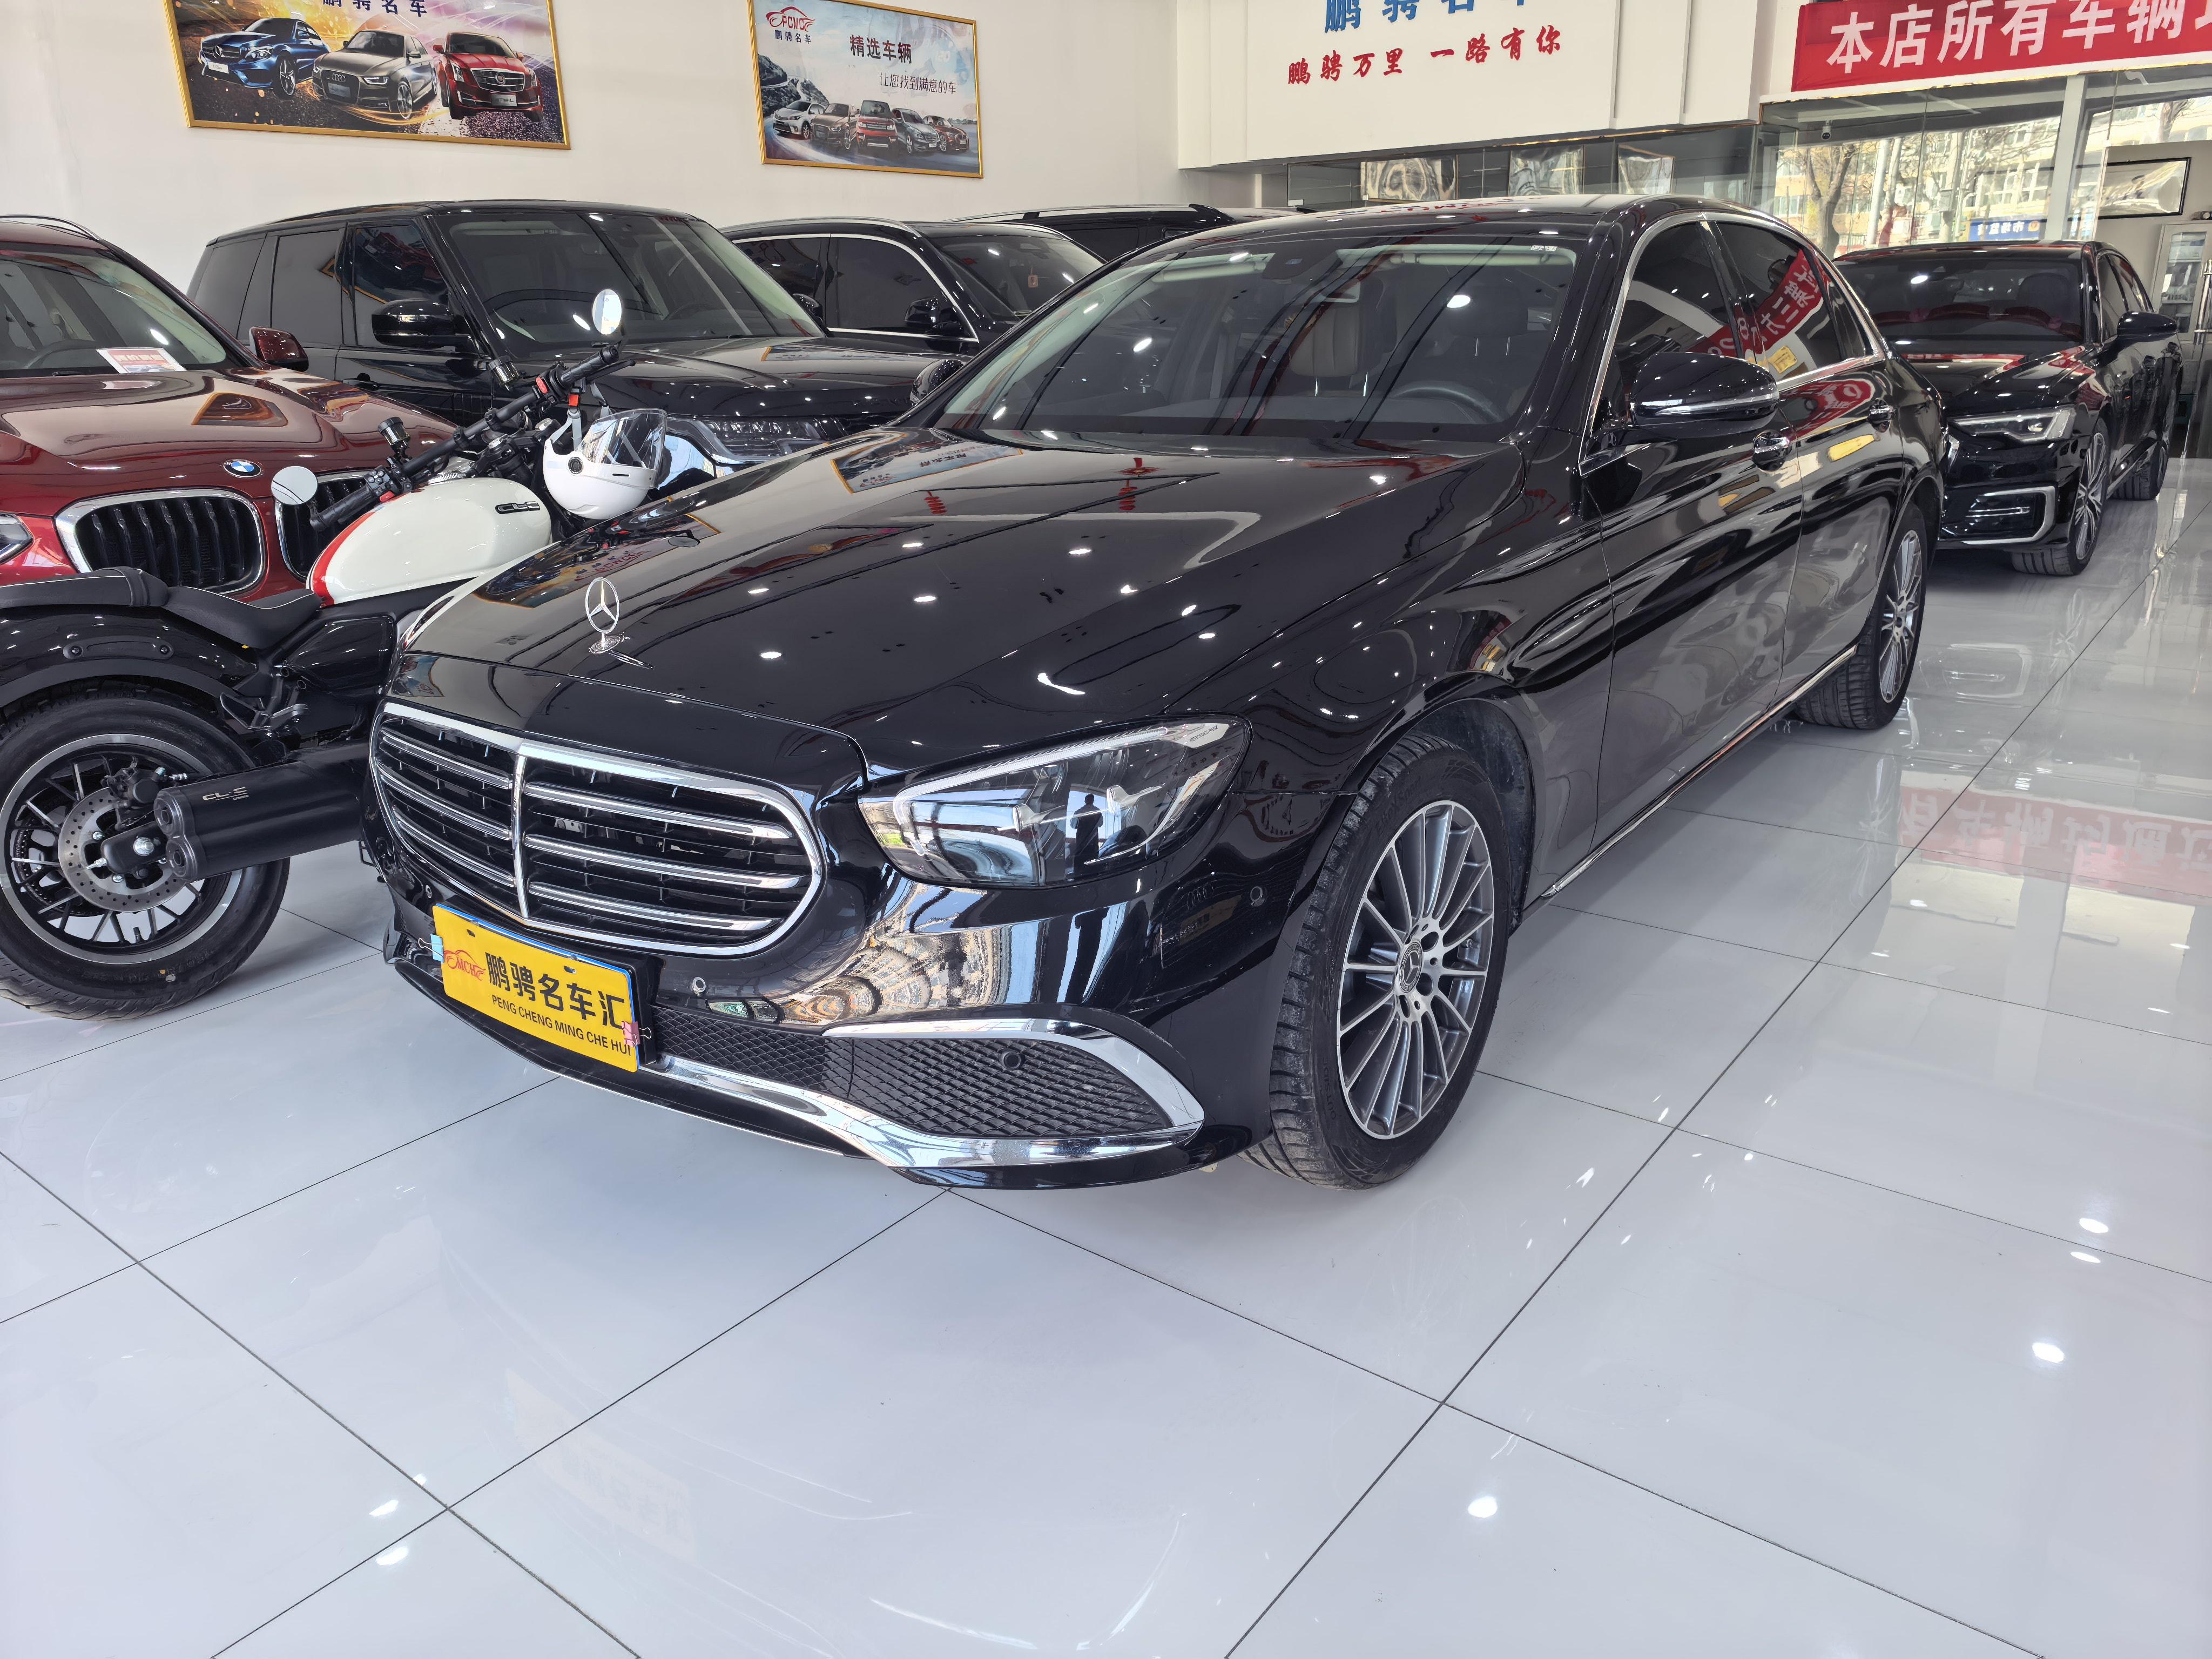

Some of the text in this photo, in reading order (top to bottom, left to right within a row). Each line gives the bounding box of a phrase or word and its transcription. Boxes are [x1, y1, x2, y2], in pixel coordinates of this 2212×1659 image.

[849, 34, 912, 64] 精选车辆
[1288, 24, 1561, 85] 鹏骋万里 一路有你
[1827, 0, 2212, 74] 本店所有车辆
[880, 72, 957, 95] 让您找到满意的车
[1189, 725, 1218, 743] MERCEDES-BENZ
[485, 952, 624, 1030] 鹏骋名车汇
[492, 994, 631, 1056] PENG CHENG MING CHE HUI
